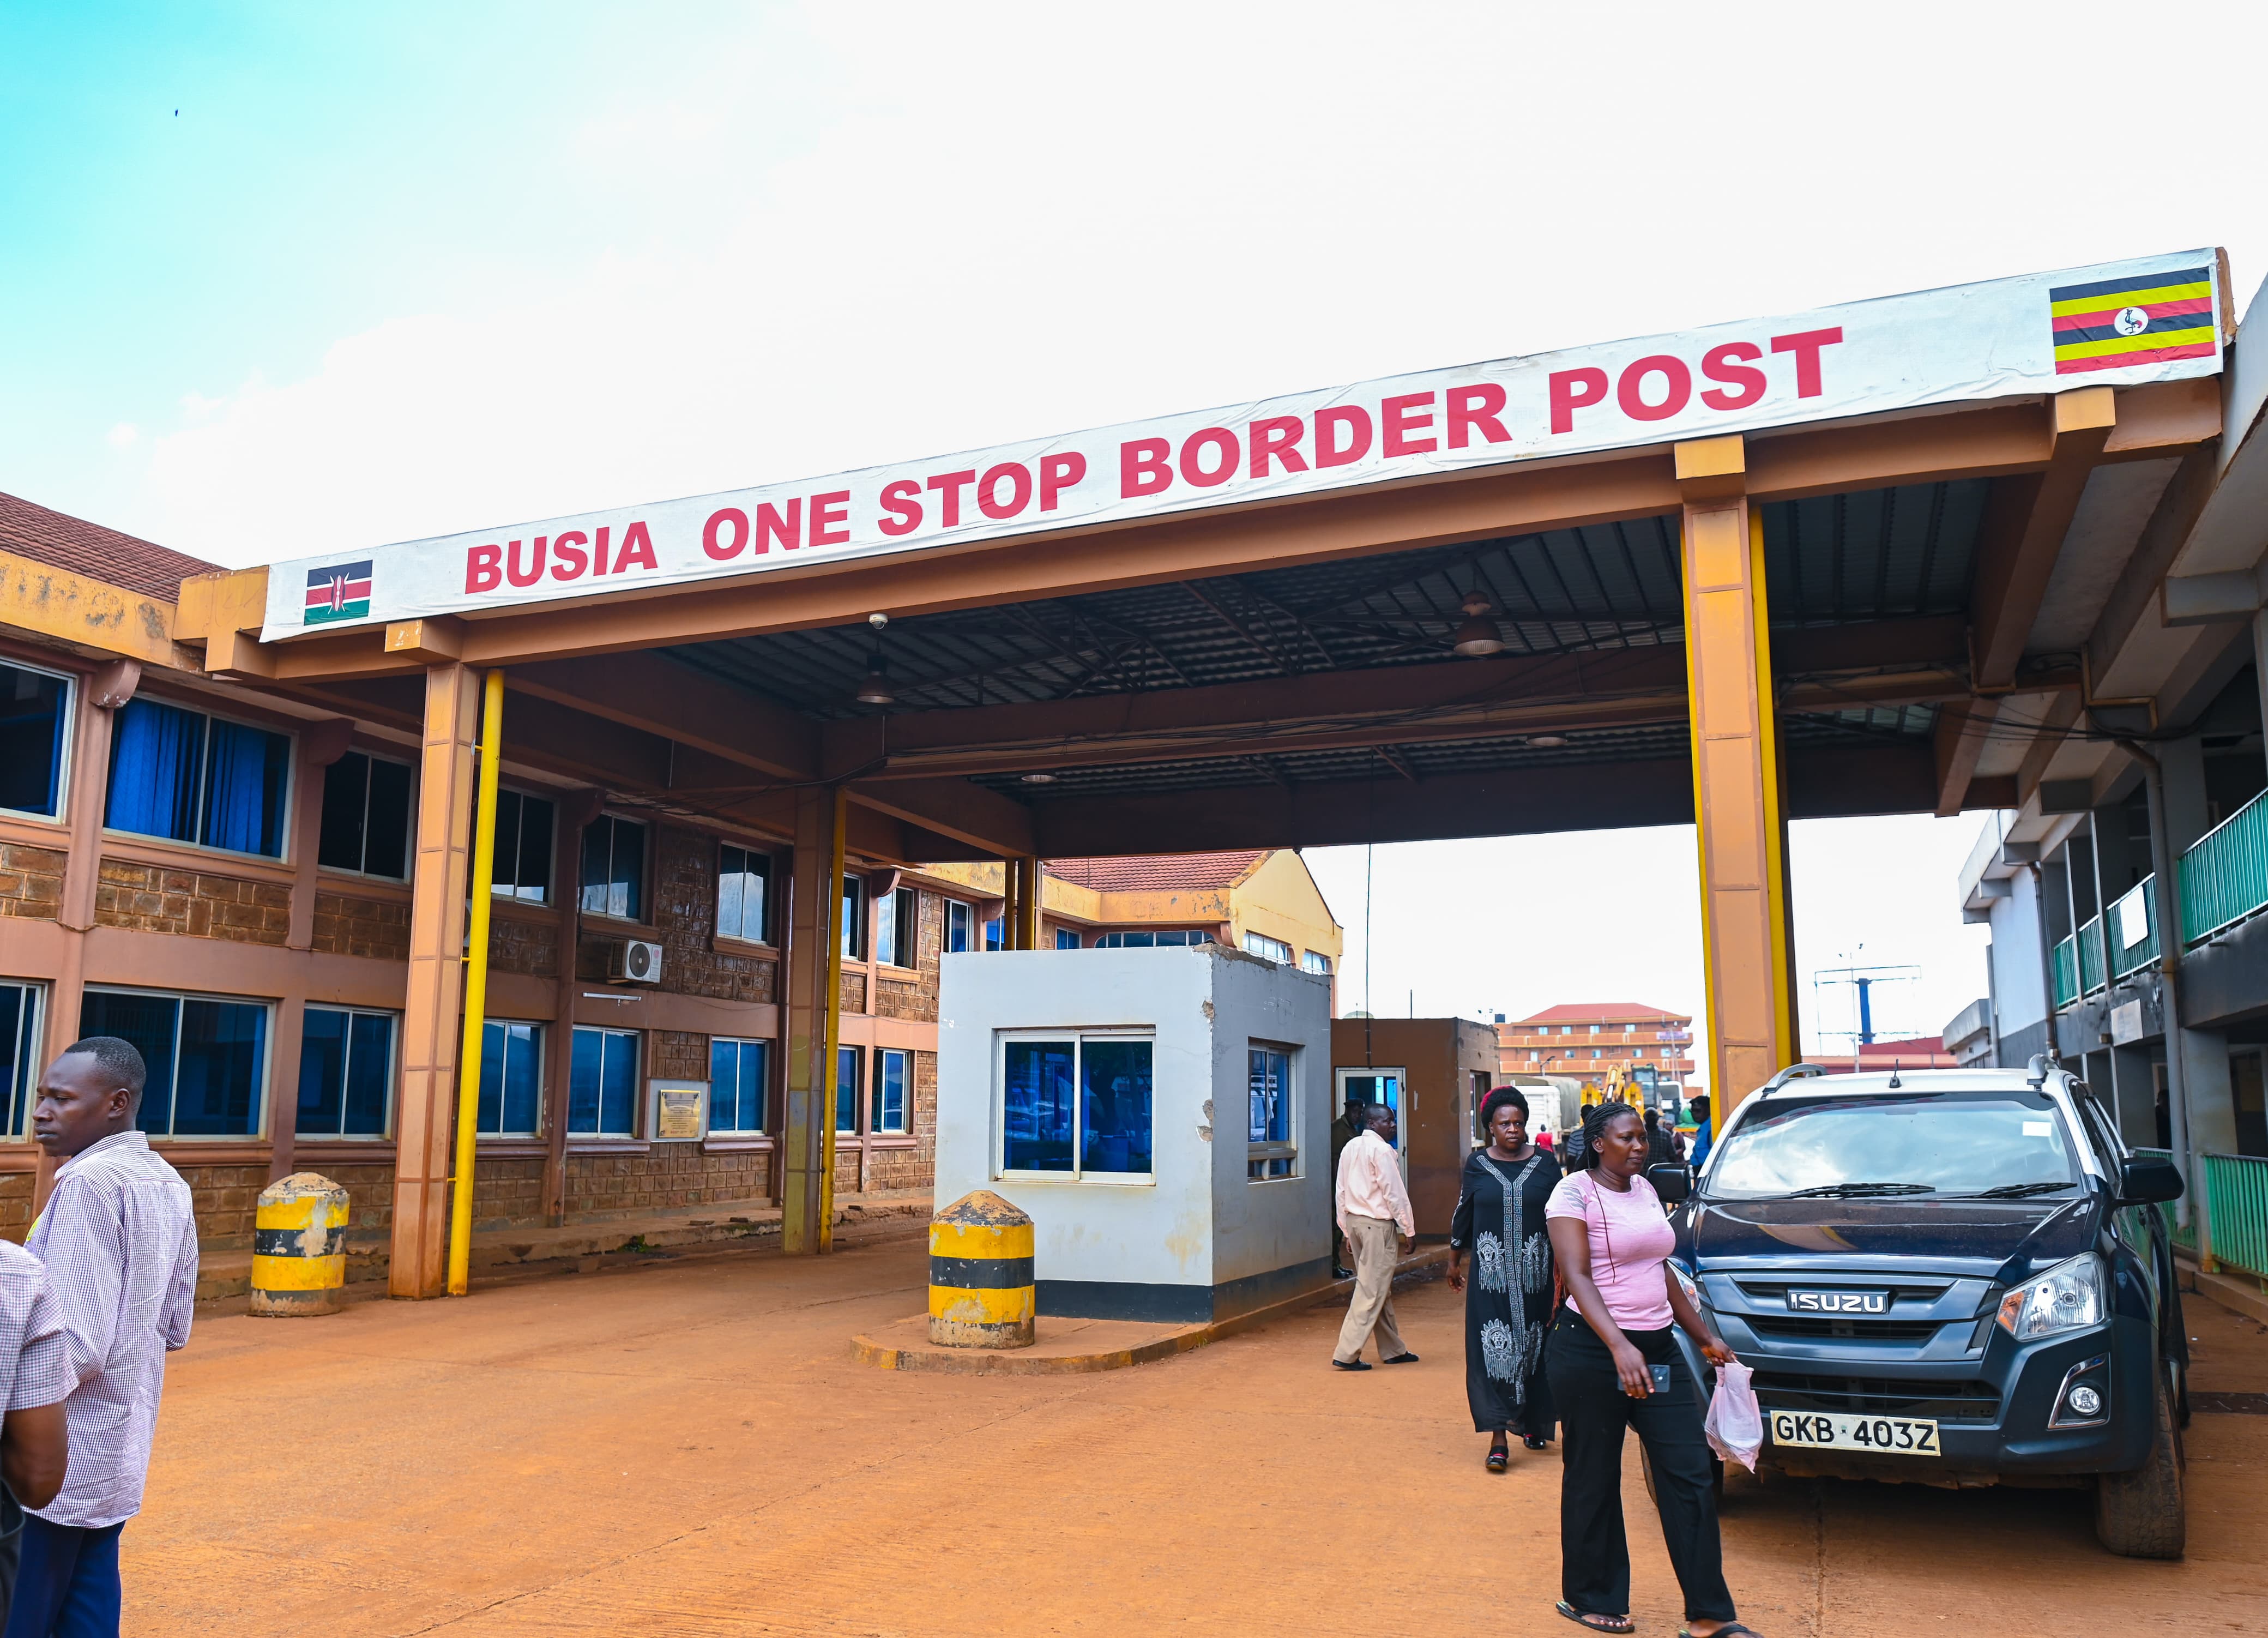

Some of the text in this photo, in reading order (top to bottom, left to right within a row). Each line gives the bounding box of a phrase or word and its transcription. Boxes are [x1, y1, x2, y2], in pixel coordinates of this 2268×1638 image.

[466, 327, 1842, 594] BUSIA ONE STOP BORDER POST
[1790, 1293, 1884, 1313] ISUZU
[1776, 1415, 1937, 1452] GKB 403Z
